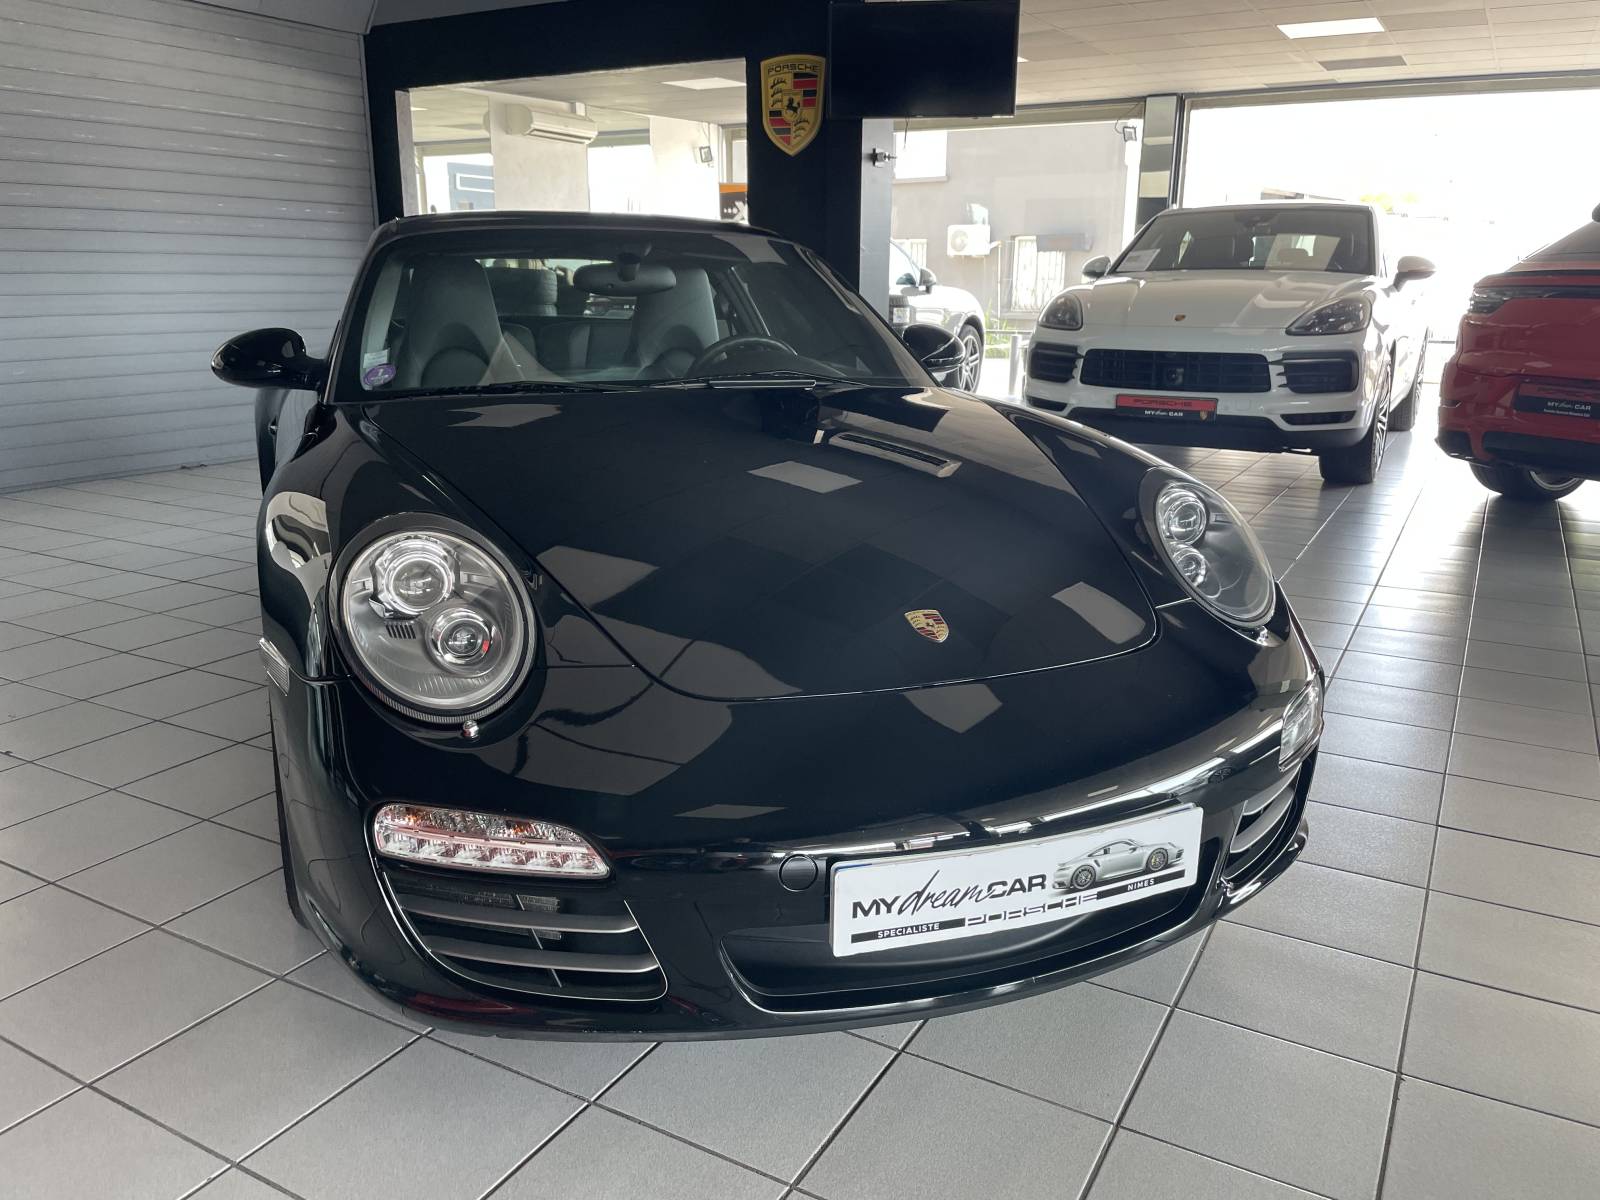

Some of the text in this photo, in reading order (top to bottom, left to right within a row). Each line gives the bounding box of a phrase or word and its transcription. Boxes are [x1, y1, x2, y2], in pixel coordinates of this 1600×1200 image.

[767, 63, 820, 75] PORSCHE
[877, 878, 1155, 939] SPECIALISTE PORSCHE NIMES
